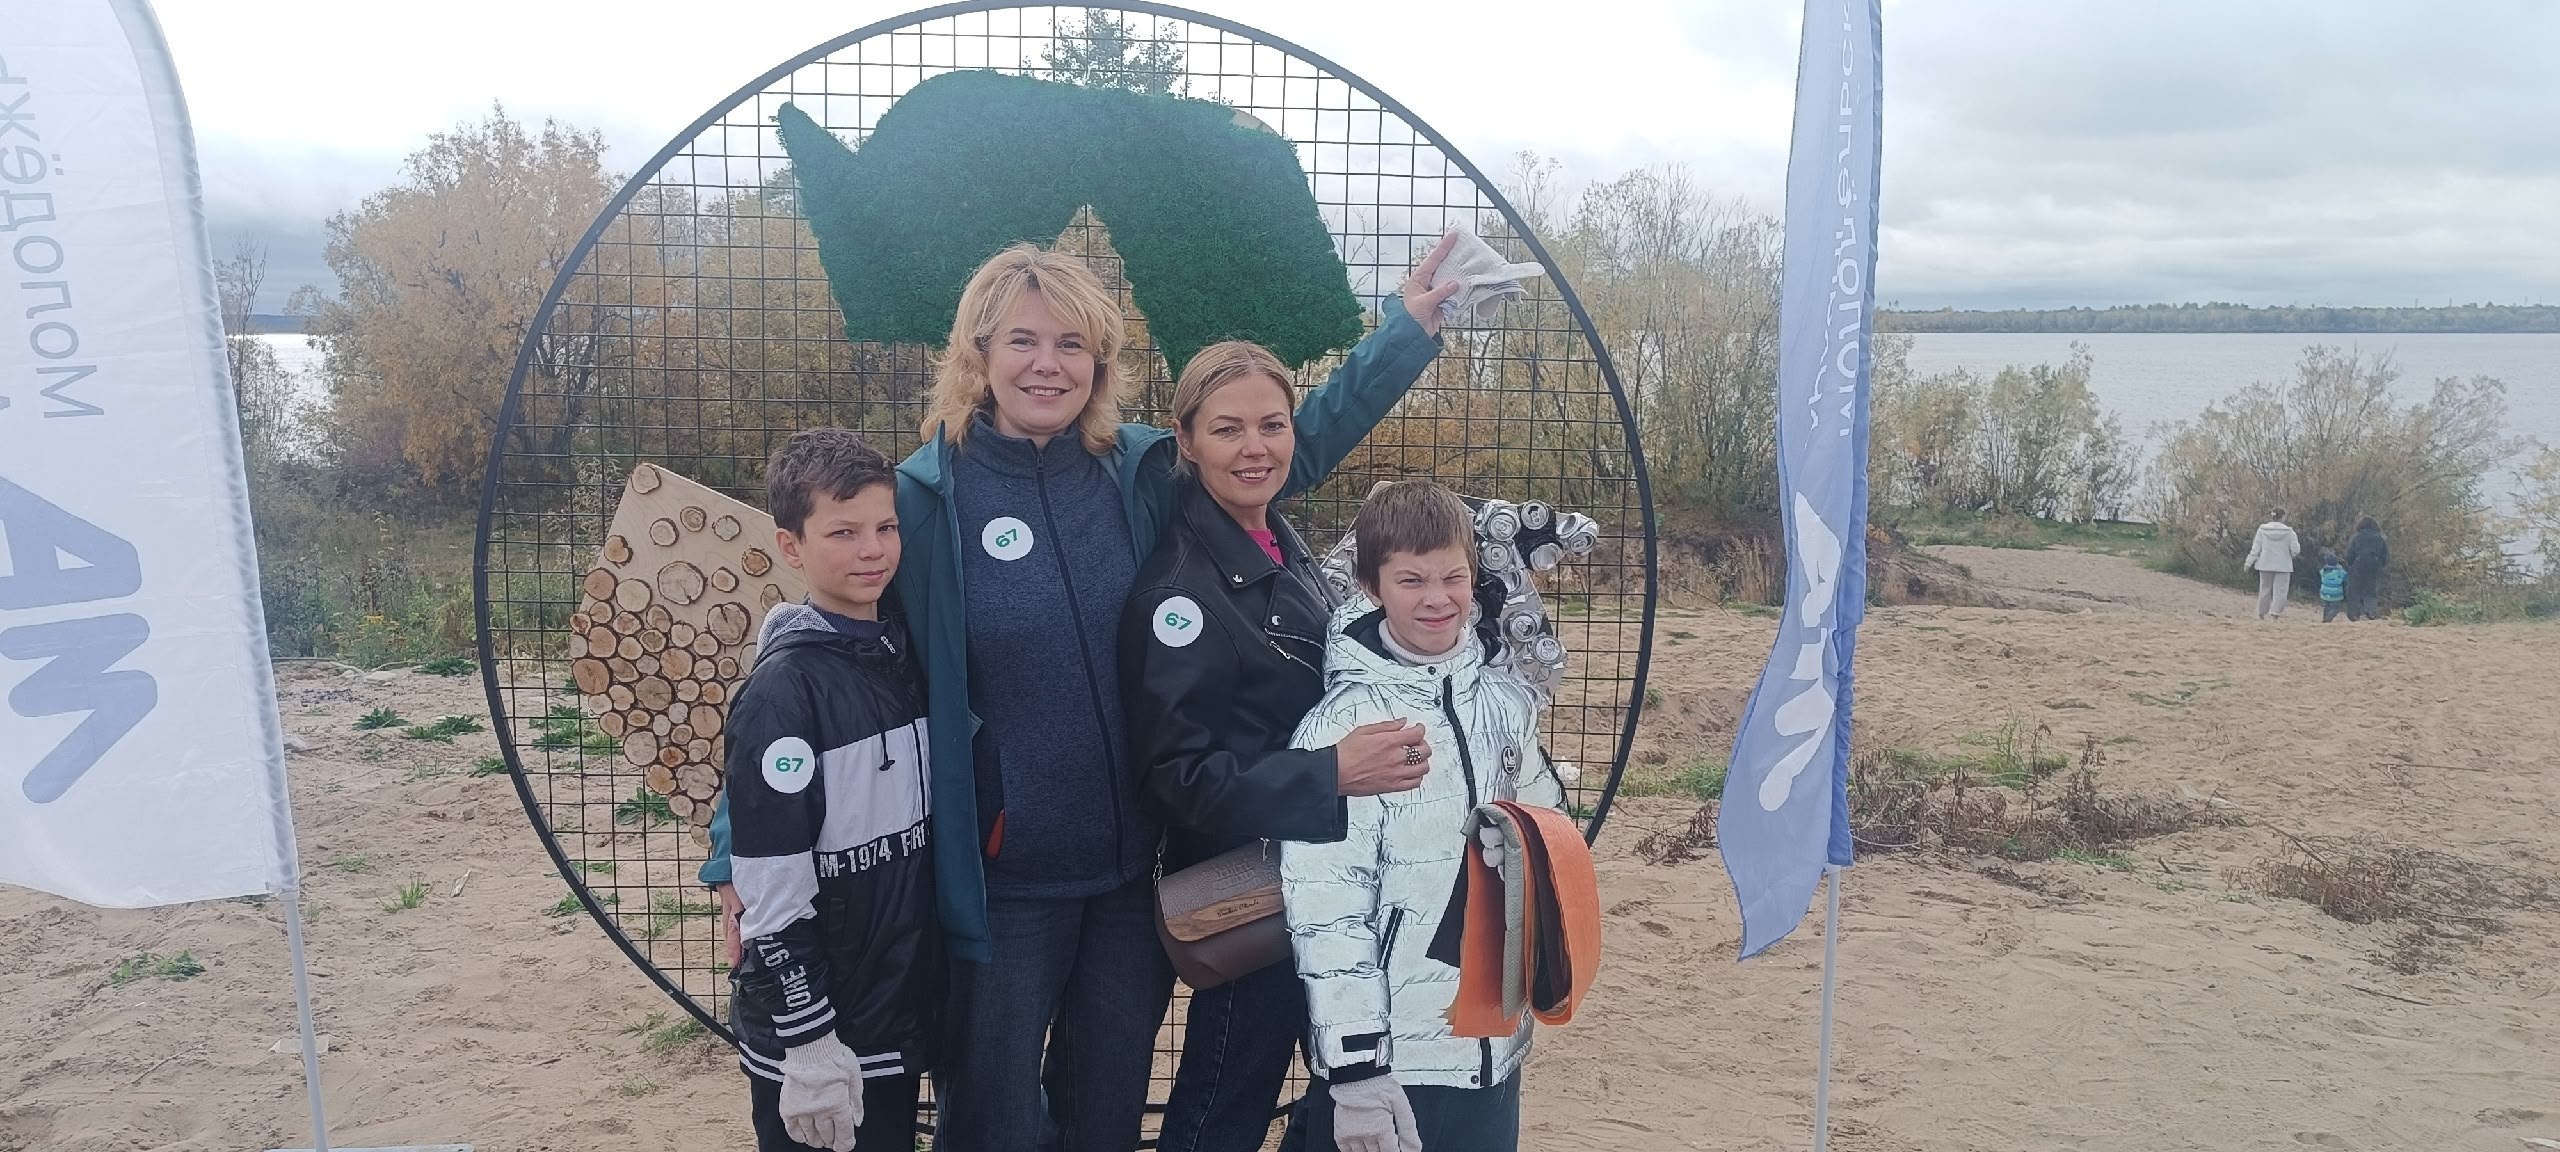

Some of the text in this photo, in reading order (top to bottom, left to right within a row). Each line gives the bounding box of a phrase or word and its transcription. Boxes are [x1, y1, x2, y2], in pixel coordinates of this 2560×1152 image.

[995, 528, 1019, 548] 67
[1164, 611, 1192, 632] 67
[775, 756, 804, 773] 67
[819, 837, 893, 878] M-1974
